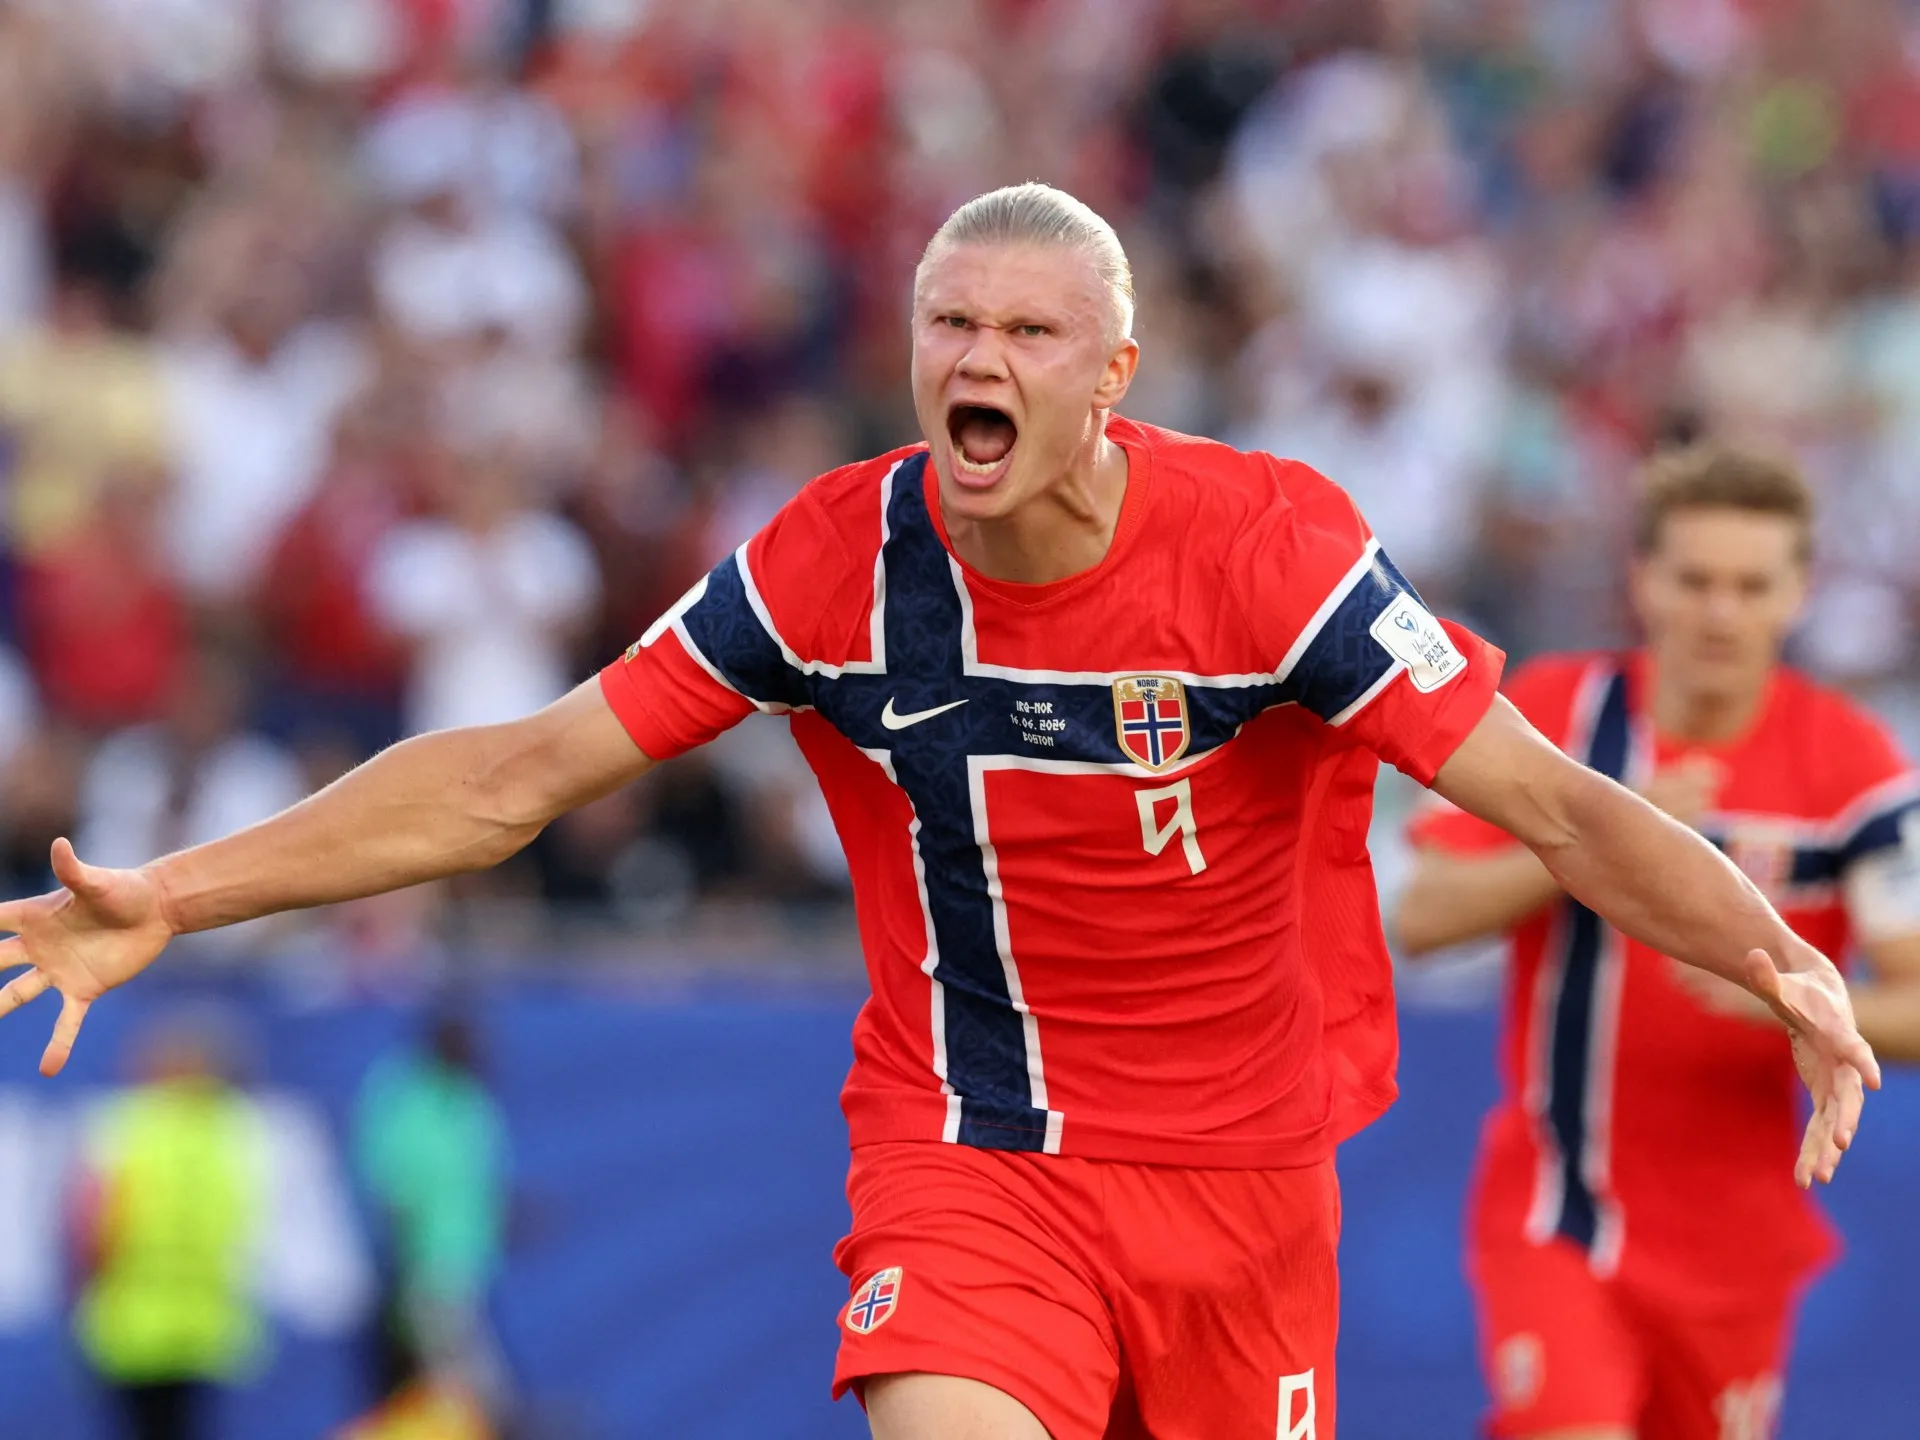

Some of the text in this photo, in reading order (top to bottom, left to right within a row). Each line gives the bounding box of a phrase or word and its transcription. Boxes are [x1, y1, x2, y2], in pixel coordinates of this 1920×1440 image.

[1424, 640, 1449, 668] PEACE
[1136, 679, 1159, 688] NORGE
[1016, 700, 1053, 714] IRQ-NOR
[1022, 731, 1055, 747] BOSTON
[1134, 776, 1208, 876] 9
